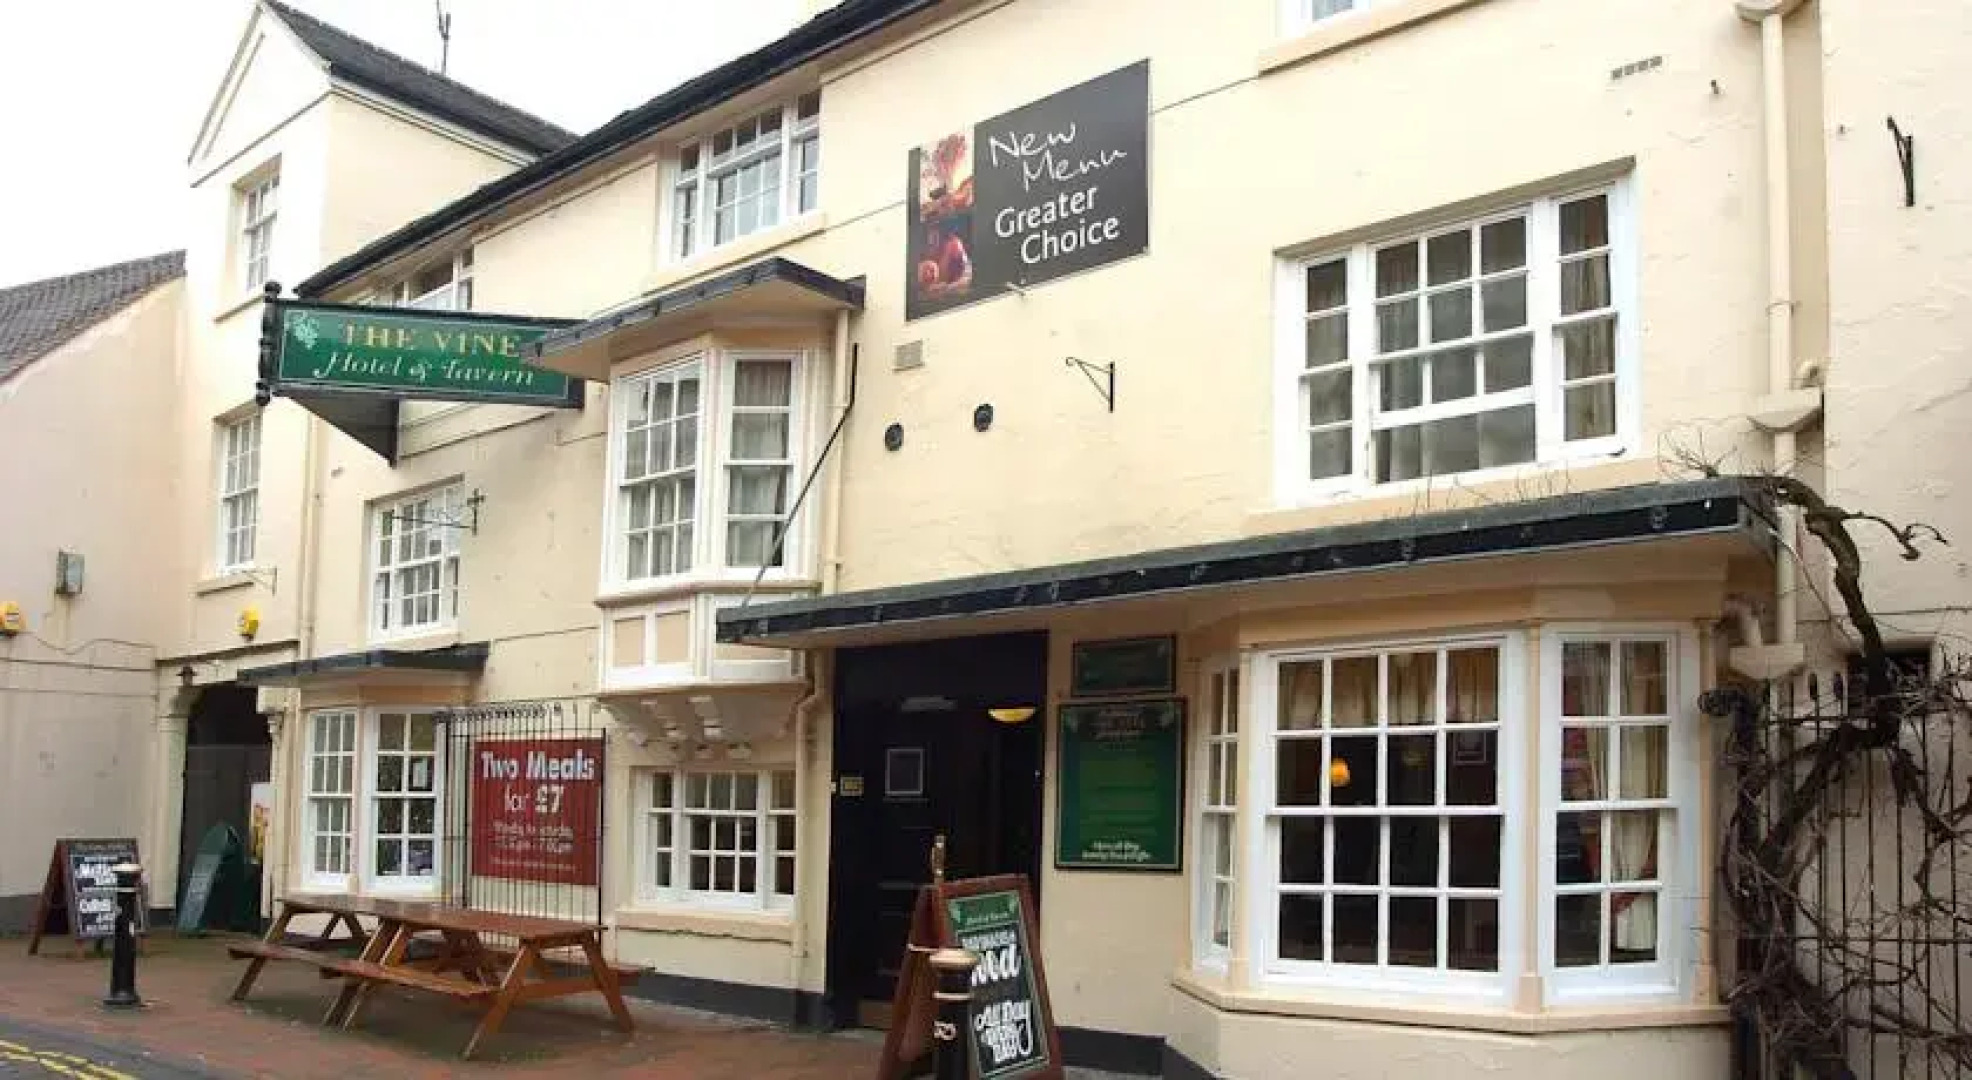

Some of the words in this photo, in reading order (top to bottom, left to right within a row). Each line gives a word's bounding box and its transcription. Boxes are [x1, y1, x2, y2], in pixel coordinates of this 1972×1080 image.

[987, 121, 1076, 168] New
[1023, 148, 1128, 192] Menu
[995, 185, 1098, 238] Greater
[1020, 215, 1120, 264] Choice
[341, 322, 415, 350] THE
[431, 329, 522, 357] VINE
[313, 351, 402, 379] Hotel
[408, 360, 428, 383] &
[441, 358, 534, 386] Tavern
[480, 751, 519, 780] Two
[526, 748, 595, 780] Meals
[504, 783, 531, 813] for
[534, 783, 565, 813] £7
